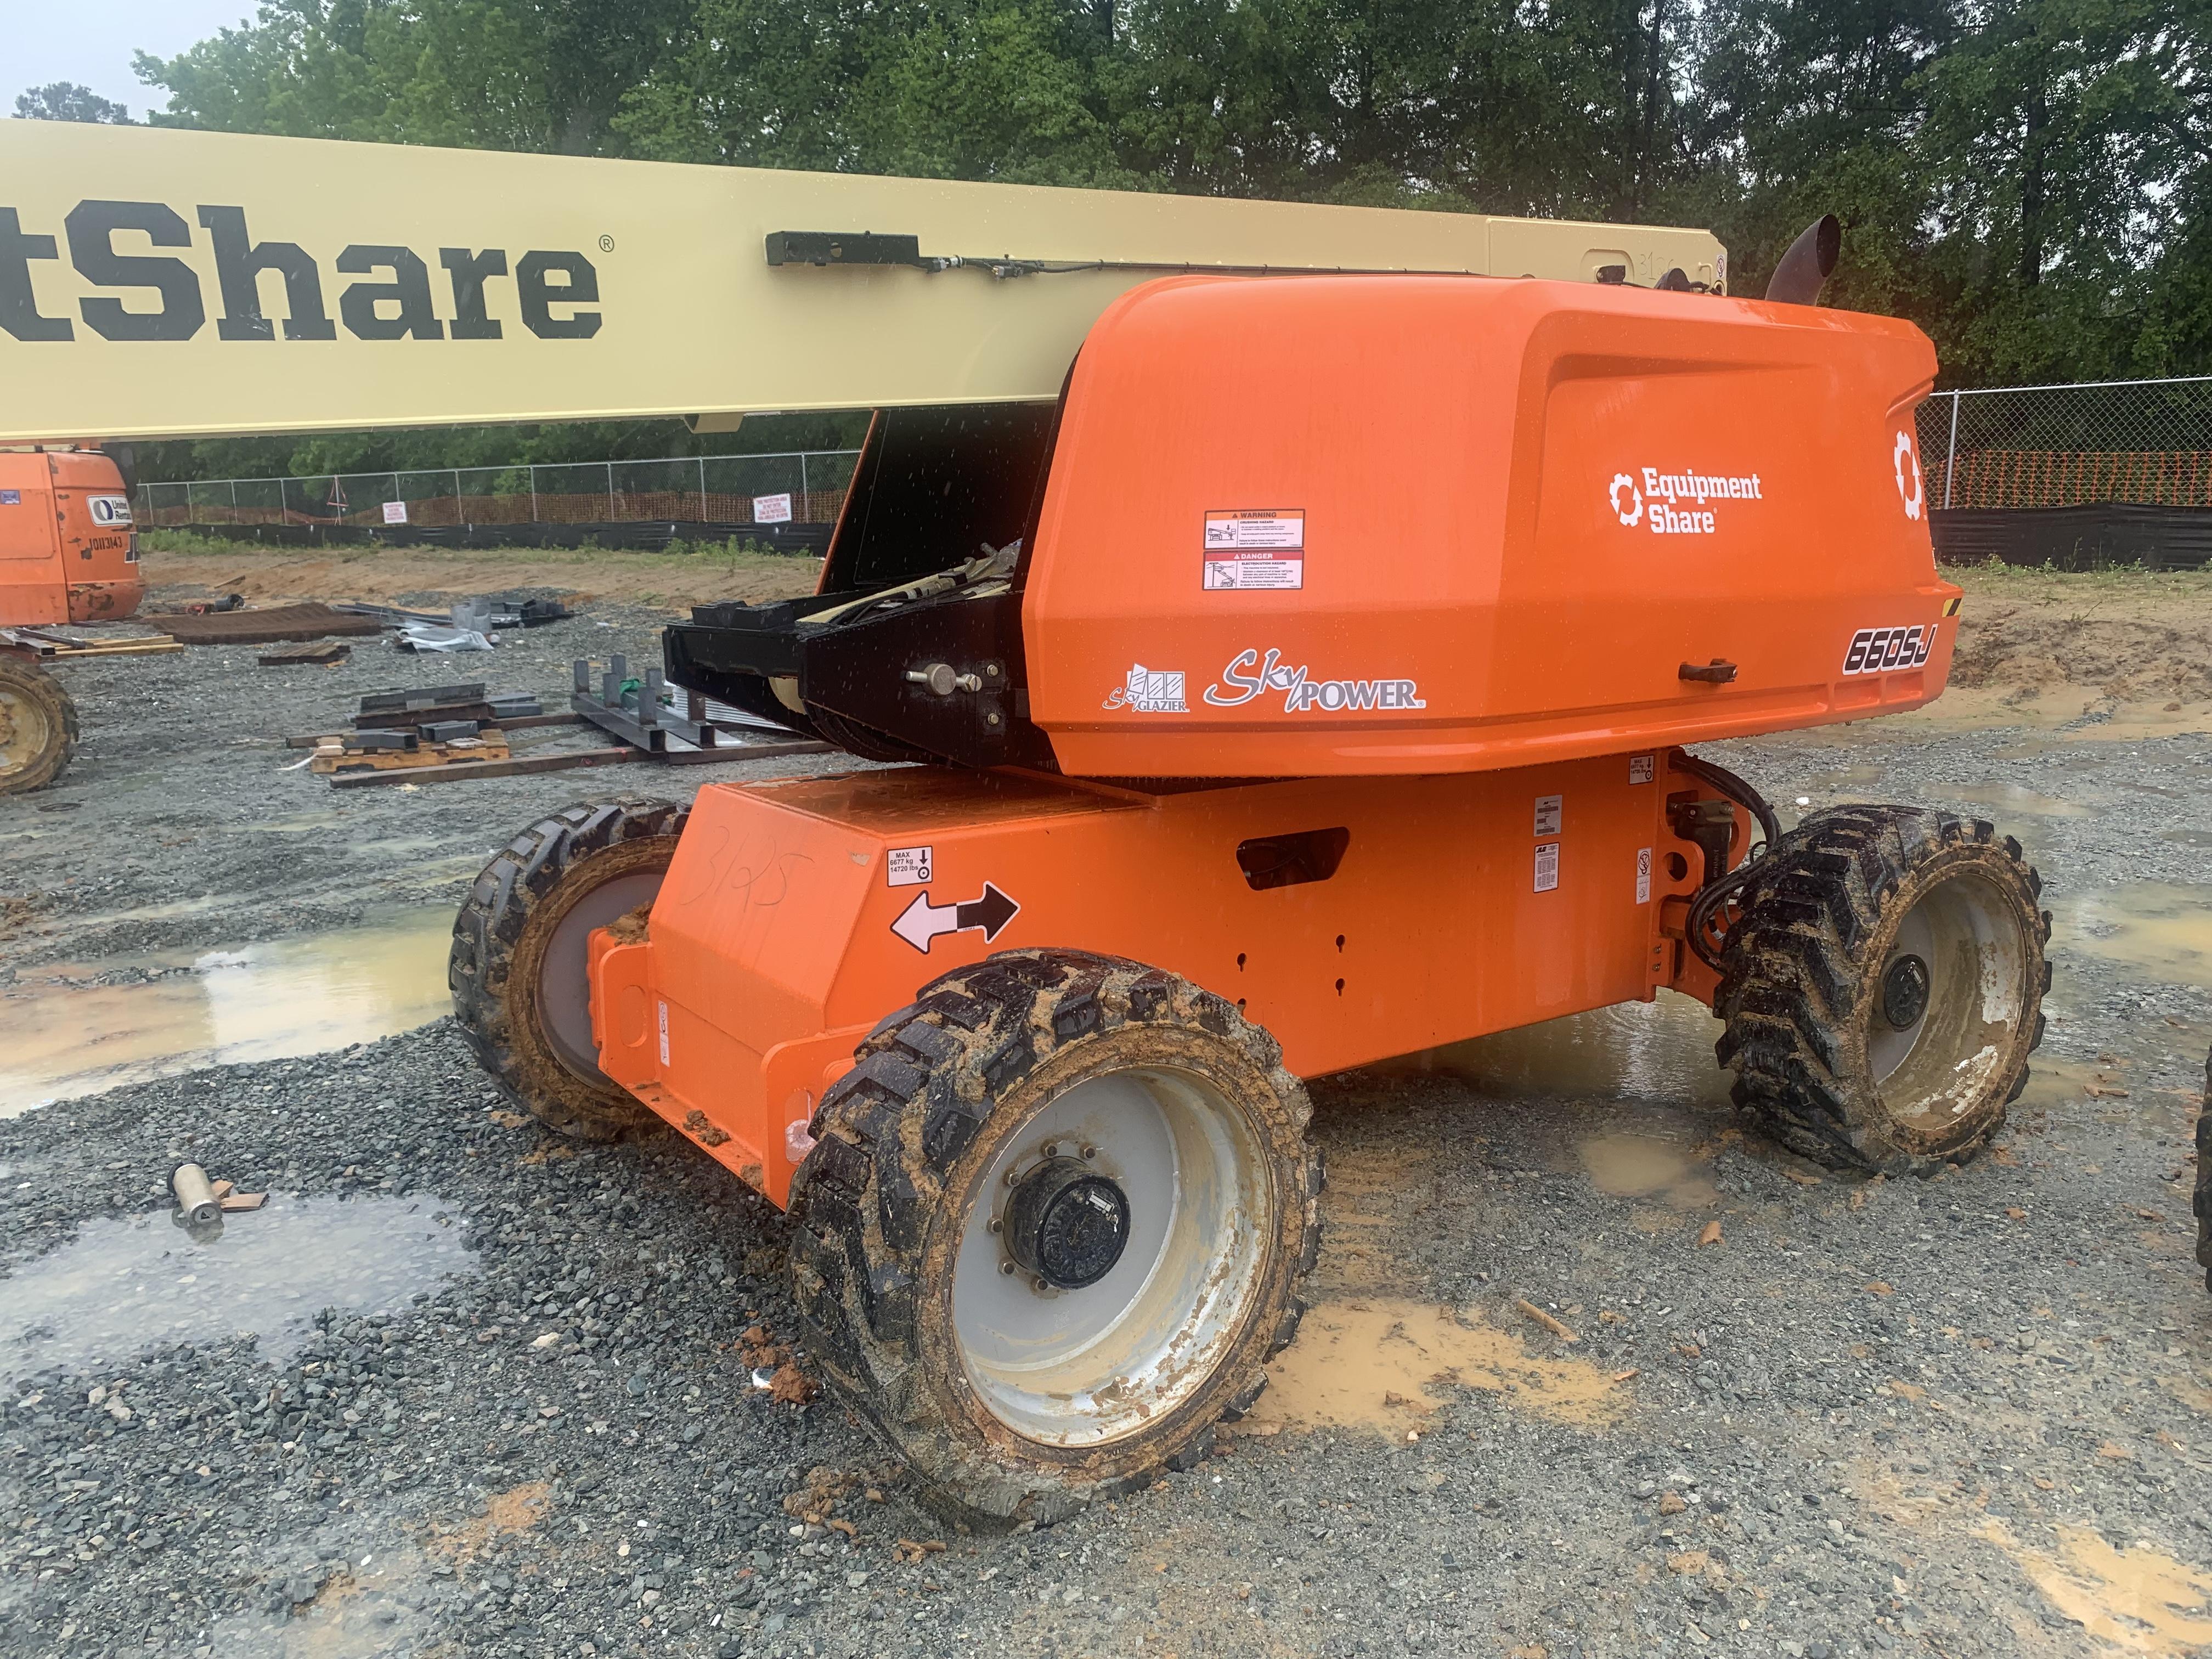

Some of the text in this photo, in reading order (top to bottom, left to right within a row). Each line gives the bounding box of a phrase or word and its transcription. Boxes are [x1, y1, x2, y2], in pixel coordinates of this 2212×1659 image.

[1641, 467, 1763, 504] Equipment
[1648, 504, 1716, 534] Share
[1842, 623, 1939, 675] 660SJ
